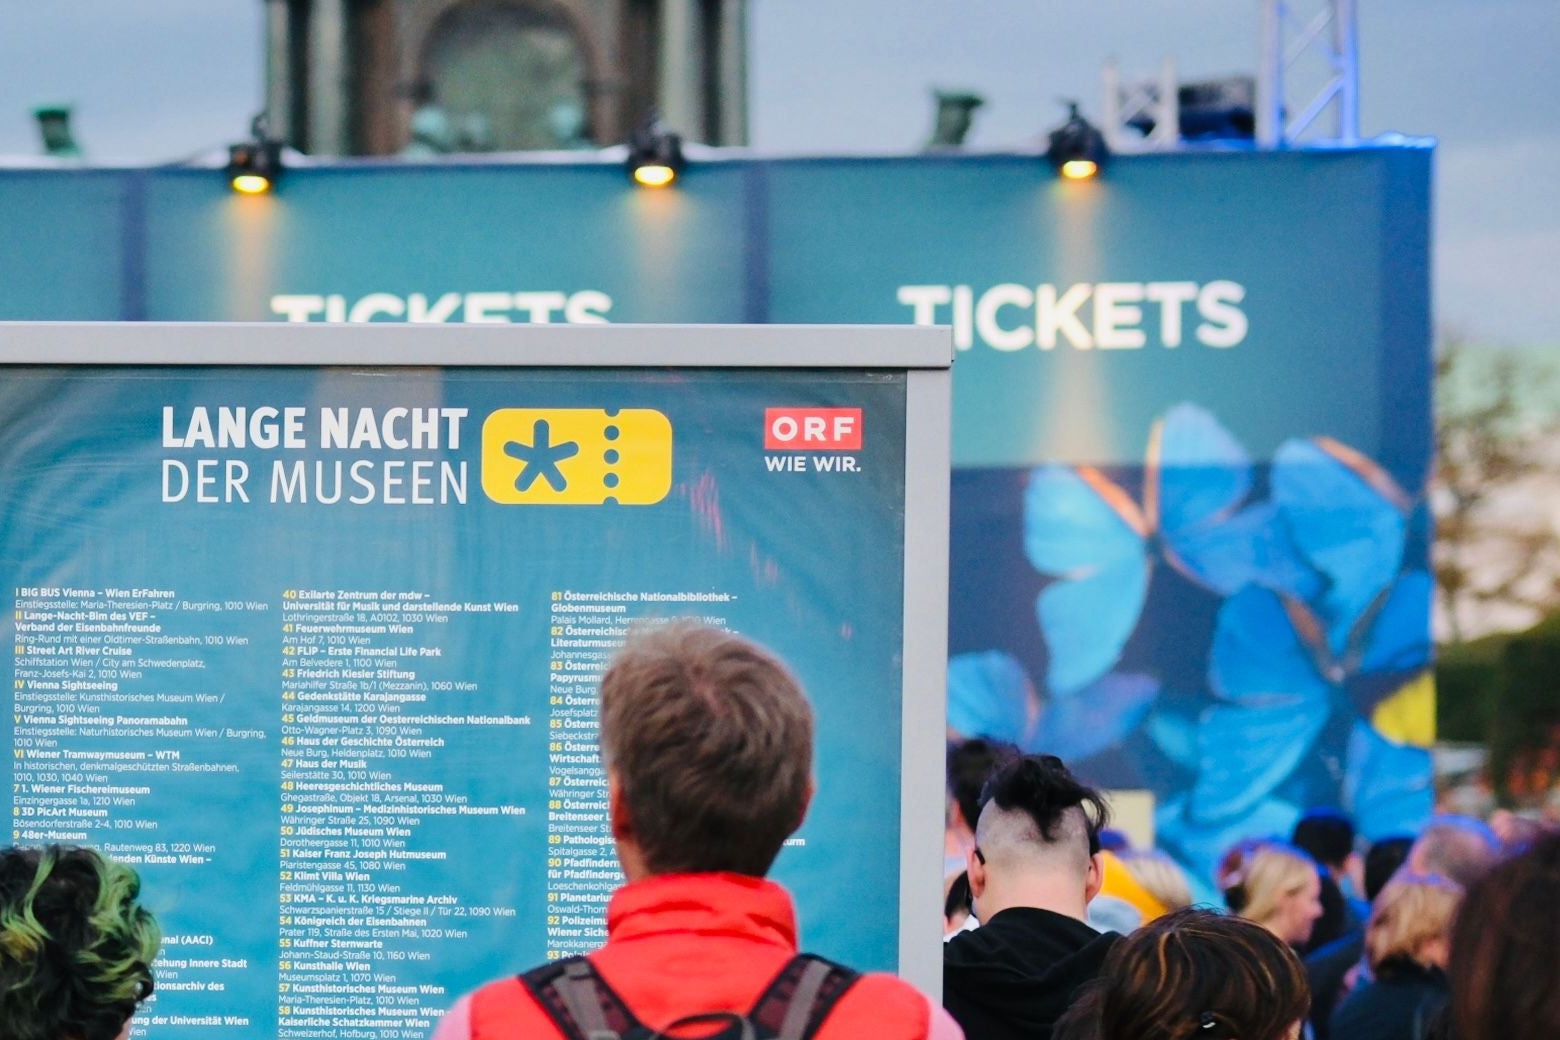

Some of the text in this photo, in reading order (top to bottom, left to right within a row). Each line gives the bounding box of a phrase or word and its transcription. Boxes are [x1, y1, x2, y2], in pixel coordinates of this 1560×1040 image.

[897, 280, 1248, 350] TICKETS
[162, 406, 469, 450] LANGE NACHT
[772, 416, 855, 442] ORF
[764, 456, 862, 472] WIE WIR.
[162, 460, 468, 505] DER MUSEEN
[16, 588, 18, 596] I
[21, 588, 38, 596] BIG
[40, 588, 60, 597] BUS
[62, 587, 95, 597] Vienna
[105, 588, 130, 597] Wien
[132, 588, 175, 598] ErFahren
[551, 591, 561, 600] 81
[564, 590, 639, 601] Österreichische
[640, 591, 731, 602] Nationalbibliothek
[282, 601, 518, 612] Universität für Musik und darstellende Kunst Wien
[552, 603, 626, 613] Globenmuseum
[15, 622, 161, 632] Verband der Eisenbahnfreunde
[283, 624, 413, 634] 41 Feuerwehrmuseum Wien
[300, 635, 316, 644] Hof
[326, 636, 345, 644] 1010
[348, 636, 370, 644] Wien
[15, 645, 132, 655] III Street Art River Cruise
[282, 668, 415, 681] 43 Friedrich Kiesler Stiftung
[15, 680, 117, 692] IV Vienna Sightseeing
[282, 691, 427, 704] 44 Gedenkstätte Karajangasse
[14, 714, 188, 726] V Vienna Sightseeing Panoramabahn
[281, 736, 444, 746] 46 Haus der Geschichte Österreich
[281, 759, 367, 768] 47 Haus der Musik
[13, 784, 19, 792] 7
[30, 783, 65, 793] Wiener
[68, 784, 151, 794] Fischereimuseum
[281, 781, 443, 793] 48 Heeresgeschichtliches Museum
[14, 796, 78, 806] Einzingergasse
[92, 797, 110, 805] 1210
[113, 797, 135, 805] Wien
[13, 807, 107, 817] 8 3D PicArt Museum
[14, 819, 158, 830] Bösendorferstraße 2-4, 1010 Wien
[13, 830, 87, 840] 9 48er-Museum
[280, 826, 410, 836] 50 Jüdisches Museum Wien
[280, 848, 447, 860] 51 Kaiser Franz Joseph Hutmuseum
[280, 871, 370, 881] 52 Klimt Villa Wien
[279, 916, 427, 928] 54 Königreich der Eisenbahnen
[279, 938, 383, 948] 55 Kuffner Sternwarte
[278, 961, 370, 971] 56 Kunsthalle Wien
[278, 983, 444, 994] 57 Kunsthistorisches Museum Wien
